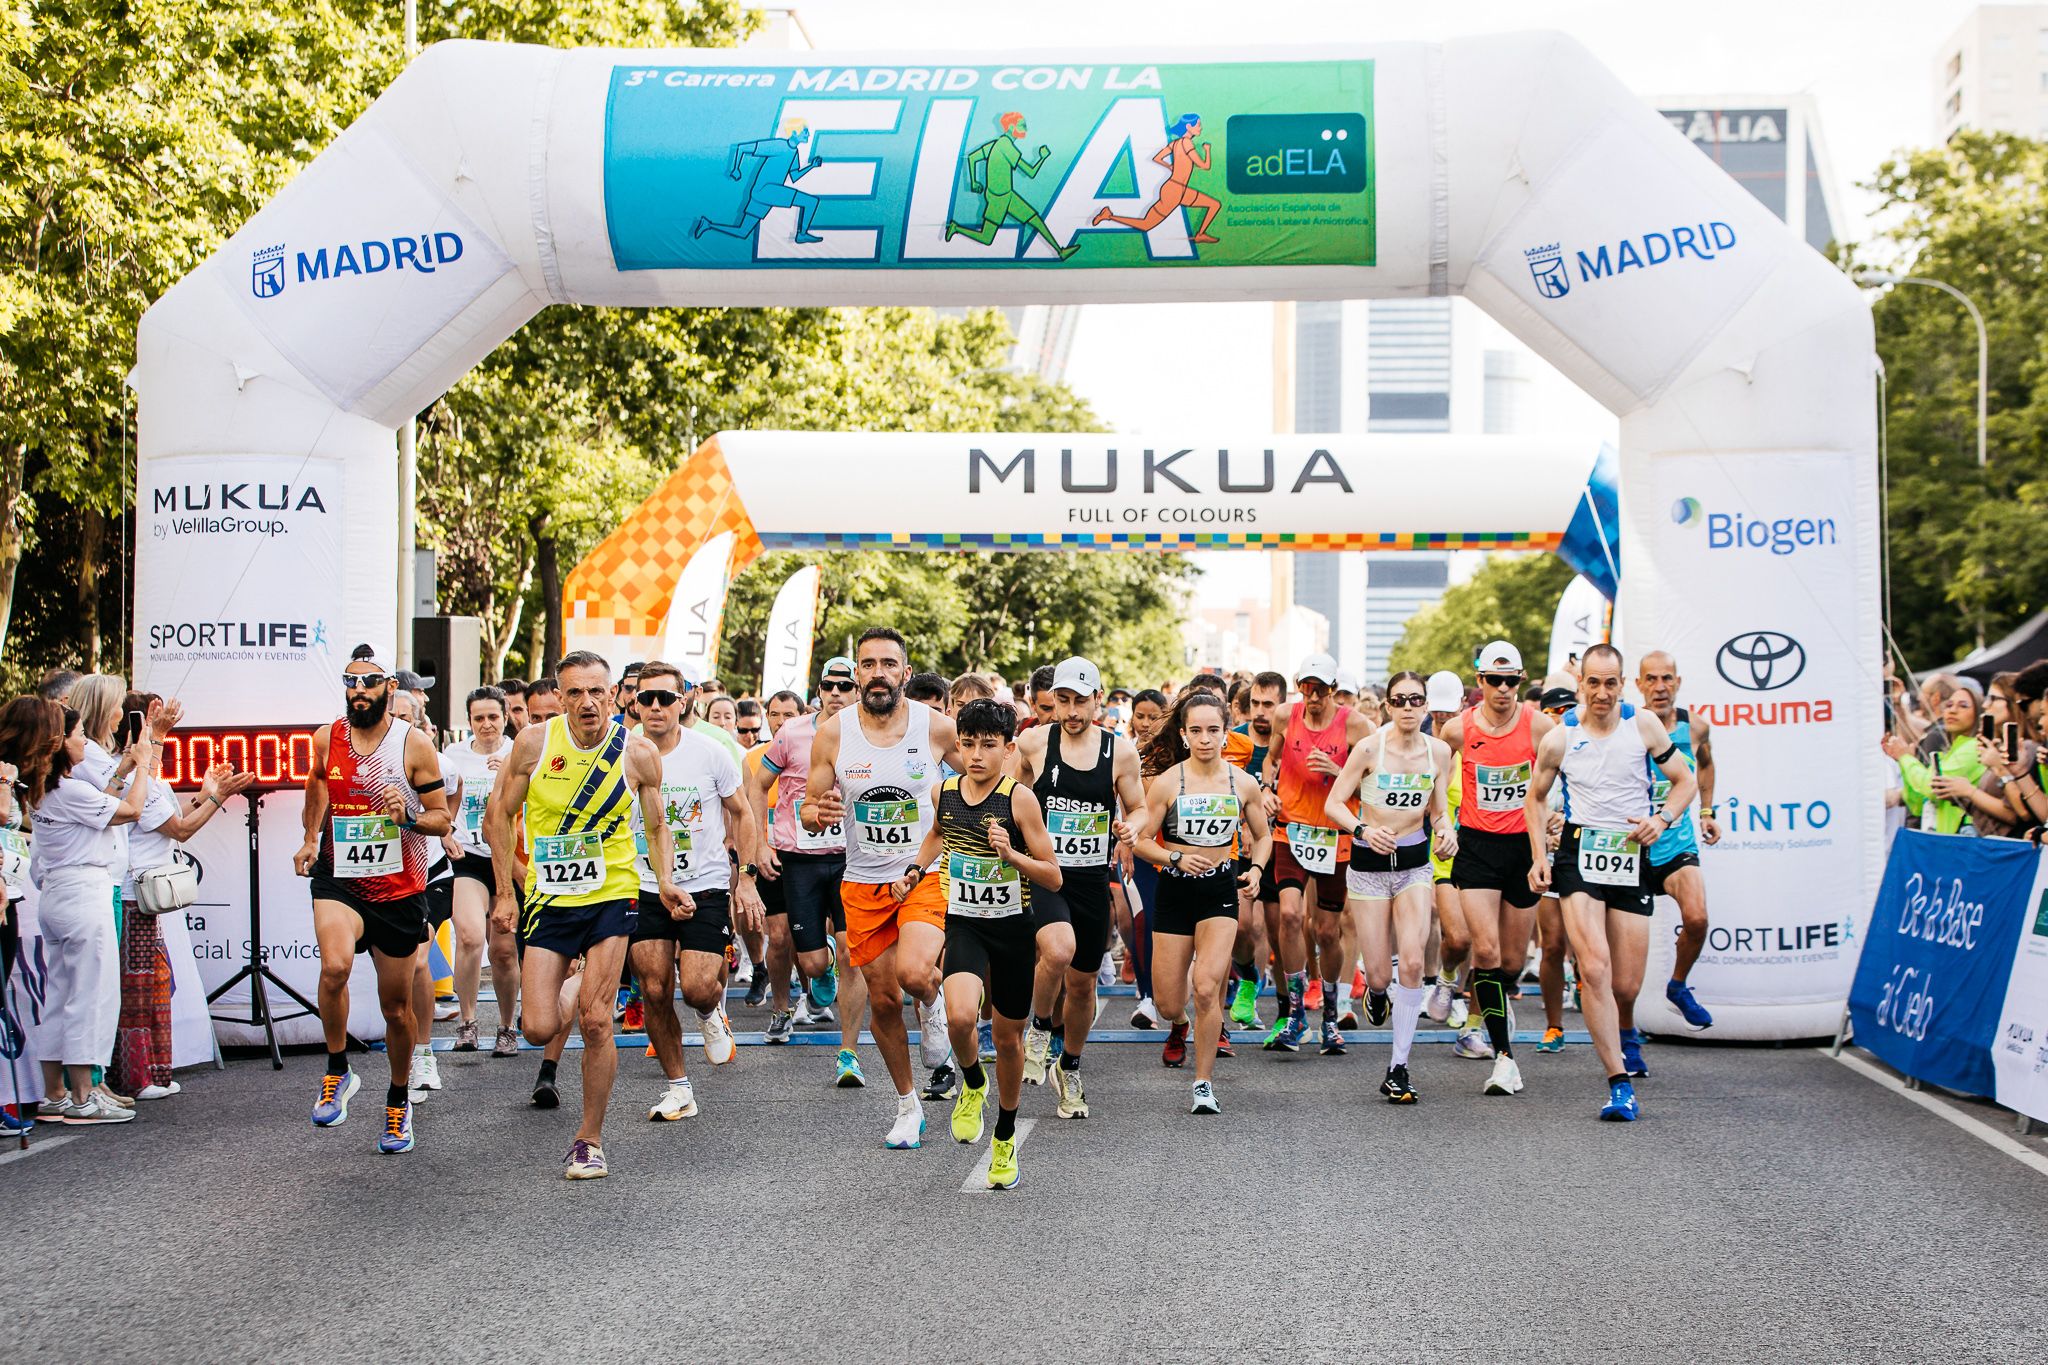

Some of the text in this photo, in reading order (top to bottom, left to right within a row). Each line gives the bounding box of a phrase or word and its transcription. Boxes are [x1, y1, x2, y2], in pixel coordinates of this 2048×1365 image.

[663, 70, 776, 88] Carrera
[786, 67, 980, 92] MADRID
[989, 67, 1085, 92] CON
[1093, 66, 1163, 90] LA
[752, 95, 1201, 264] ELA
[1327, 202, 1341, 212] de
[296, 232, 464, 283] MADRID
[1576, 221, 1737, 283] MADRID
[968, 448, 1355, 494] MUKUA
[154, 483, 327, 514] MUKUA
[1068, 508, 1257, 523] FULL OF COLOURS
[154, 523, 169, 540] by
[1708, 512, 1836, 555] Biogen
[257, 652, 263, 661] Y
[264, 652, 307, 662] EVENTOS
[1385, 792, 1423, 807] 828
[1483, 784, 1527, 802] 1795
[1045, 795, 1093, 813] asisa
[867, 807, 906, 822] ELA
[346, 822, 385, 840] ELA
[865, 825, 912, 844] 1161
[1061, 818, 1096, 833] ELA
[1184, 819, 1233, 836] 1767
[346, 843, 389, 864] 447
[547, 840, 587, 858] ELA
[1054, 836, 1101, 856] 1651
[1294, 844, 1328, 862] 509
[543, 860, 599, 883] 1224
[962, 861, 1003, 881] ELA
[1584, 853, 1635, 874] 1094
[958, 881, 1011, 905] 1143
[1898, 872, 1927, 938] De
[1936, 877, 1984, 951] Base
[185, 912, 206, 931] ta
[192, 939, 321, 960] cial Service
